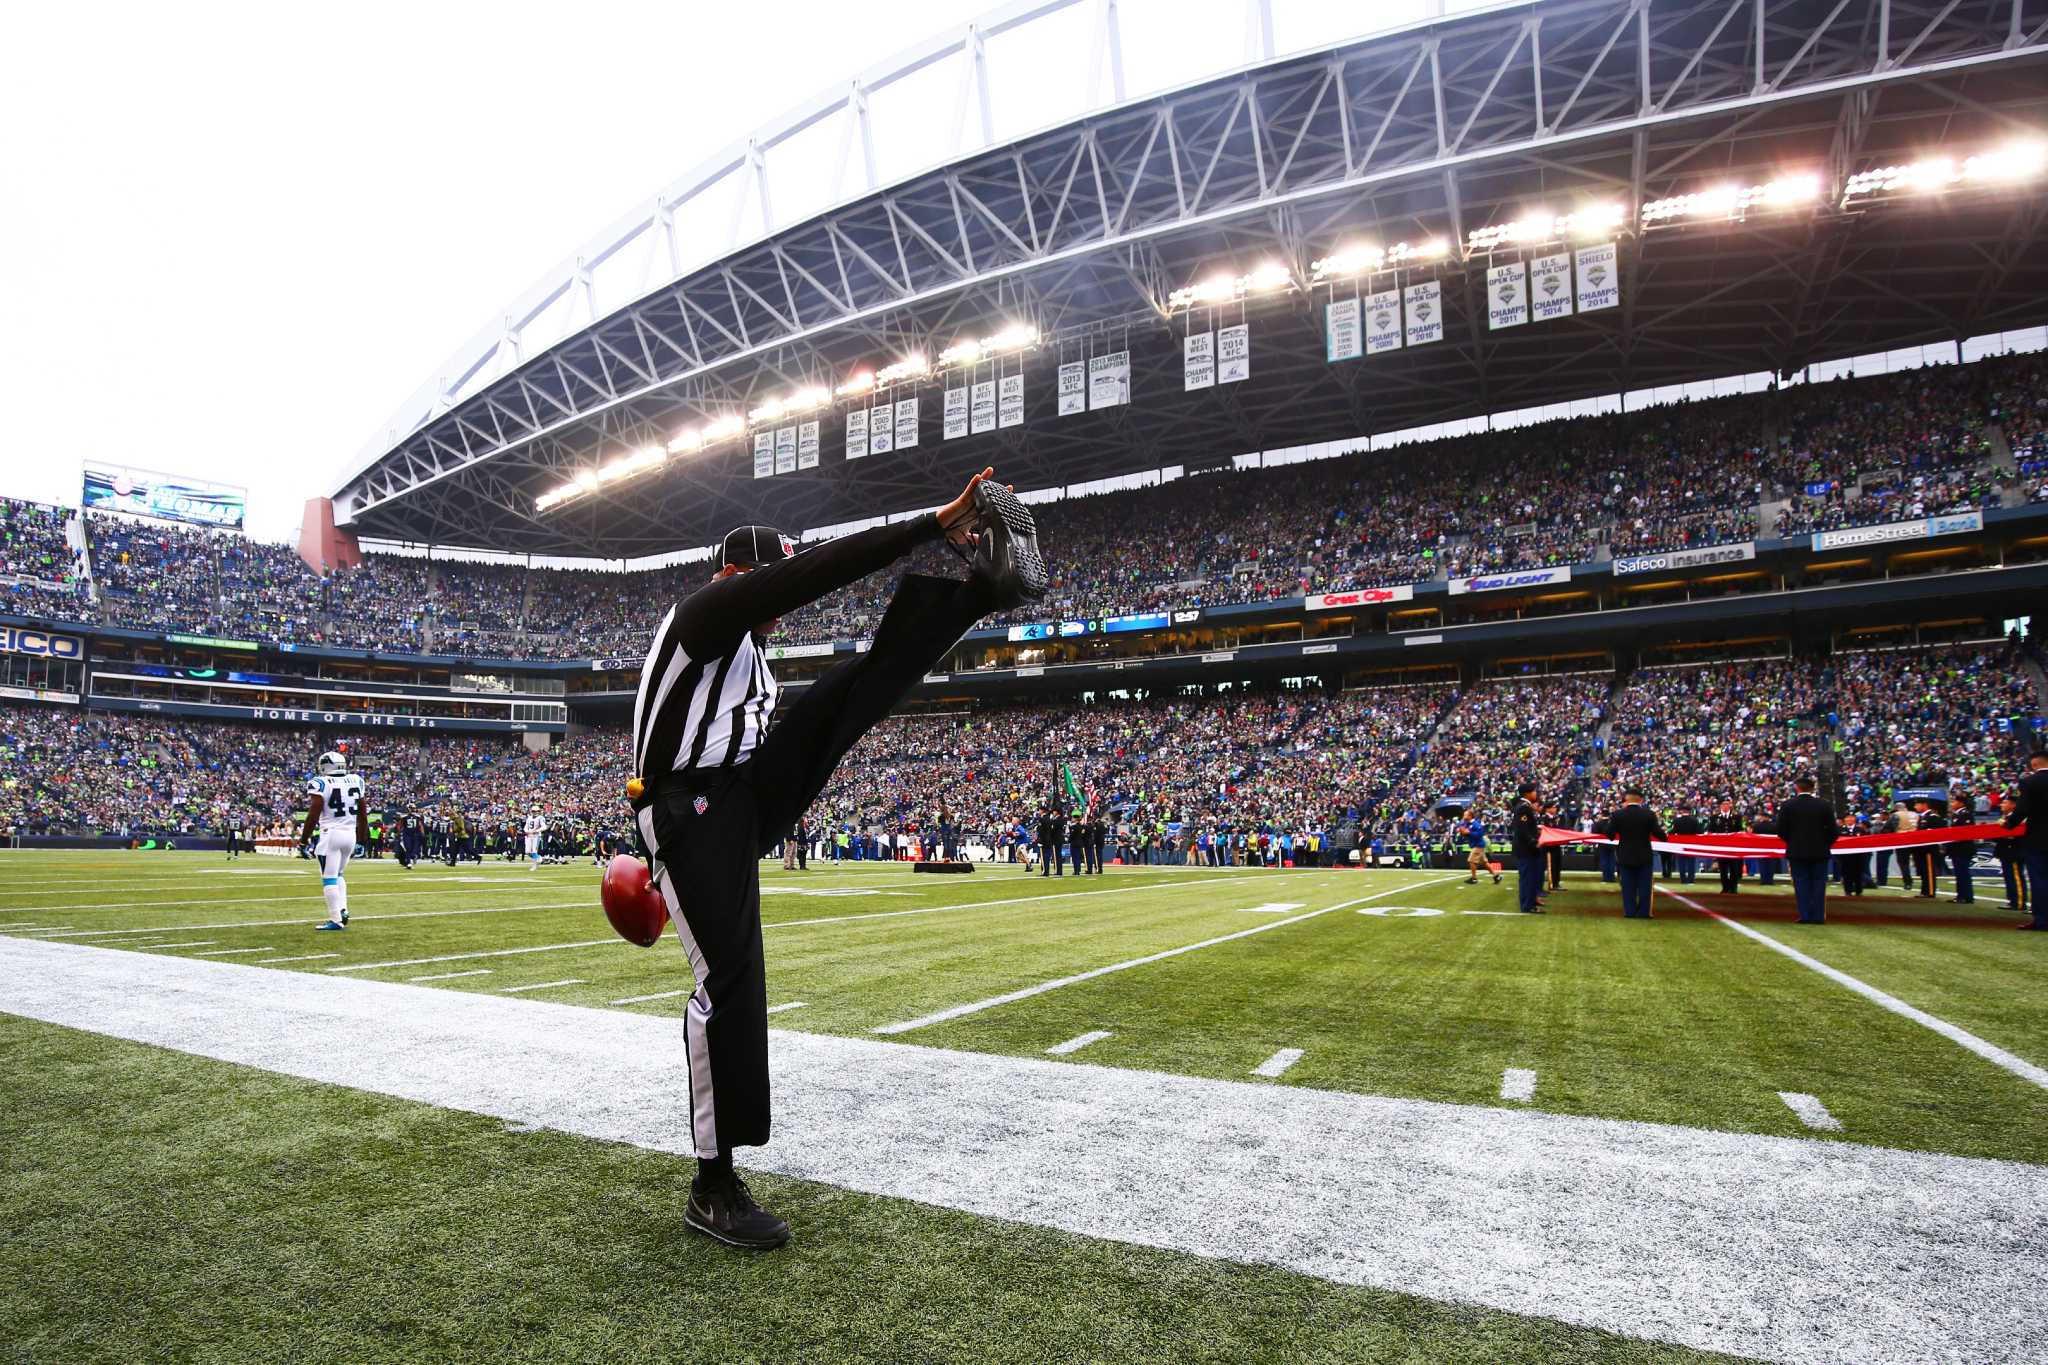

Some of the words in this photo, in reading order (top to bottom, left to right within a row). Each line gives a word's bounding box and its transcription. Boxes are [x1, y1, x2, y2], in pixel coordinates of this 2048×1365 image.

[1579, 252, 1614, 266] SHIELD
[1497, 267, 1514, 277] U.S.
[1532, 266, 1552, 277] OPEN
[1553, 264, 1569, 273] CUP
[1489, 276, 1508, 286] OPEN
[1509, 272, 1525, 282] CUP
[1406, 295, 1424, 304] OPEN
[1425, 291, 1440, 300] CUP
[1579, 287, 1618, 301] CHAMPS
[1534, 296, 1571, 310] CHAMPS
[1587, 297, 1609, 307] 2014
[1490, 305, 1526, 319] CHAMPS
[1542, 306, 1563, 316] 2014
[1499, 315, 1517, 324] 2011
[1408, 322, 1441, 335] CHAMPS
[1192, 336, 1206, 345] NFC
[1368, 330, 1401, 344] CHAMPS
[1415, 331, 1434, 341] 2010
[1190, 343, 1208, 353] WEST
[1222, 339, 1244, 350] 2014
[1226, 347, 1241, 356] NFC
[1091, 360, 1128, 373] CHAMPIONS
[1186, 367, 1213, 377] CHAMPS
[1191, 374, 1208, 384] 2014
[973, 411, 995, 421] CHAMPS
[1000, 406, 1023, 416] CHAMPS
[945, 417, 967, 427] CHAMPS
[1824, 524, 1927, 547] HomeStreet
[1937, 516, 1977, 533] Bank
[1618, 557, 1667, 573] Safeco
[1672, 549, 1745, 567] insurance
[1504, 573, 1555, 587] LIGHT
[254, 709, 309, 721] HOME
[324, 714, 347, 723] OF
[360, 715, 396, 726] THE
[409, 718, 436, 728] 12s
[328, 787, 361, 818] 43
